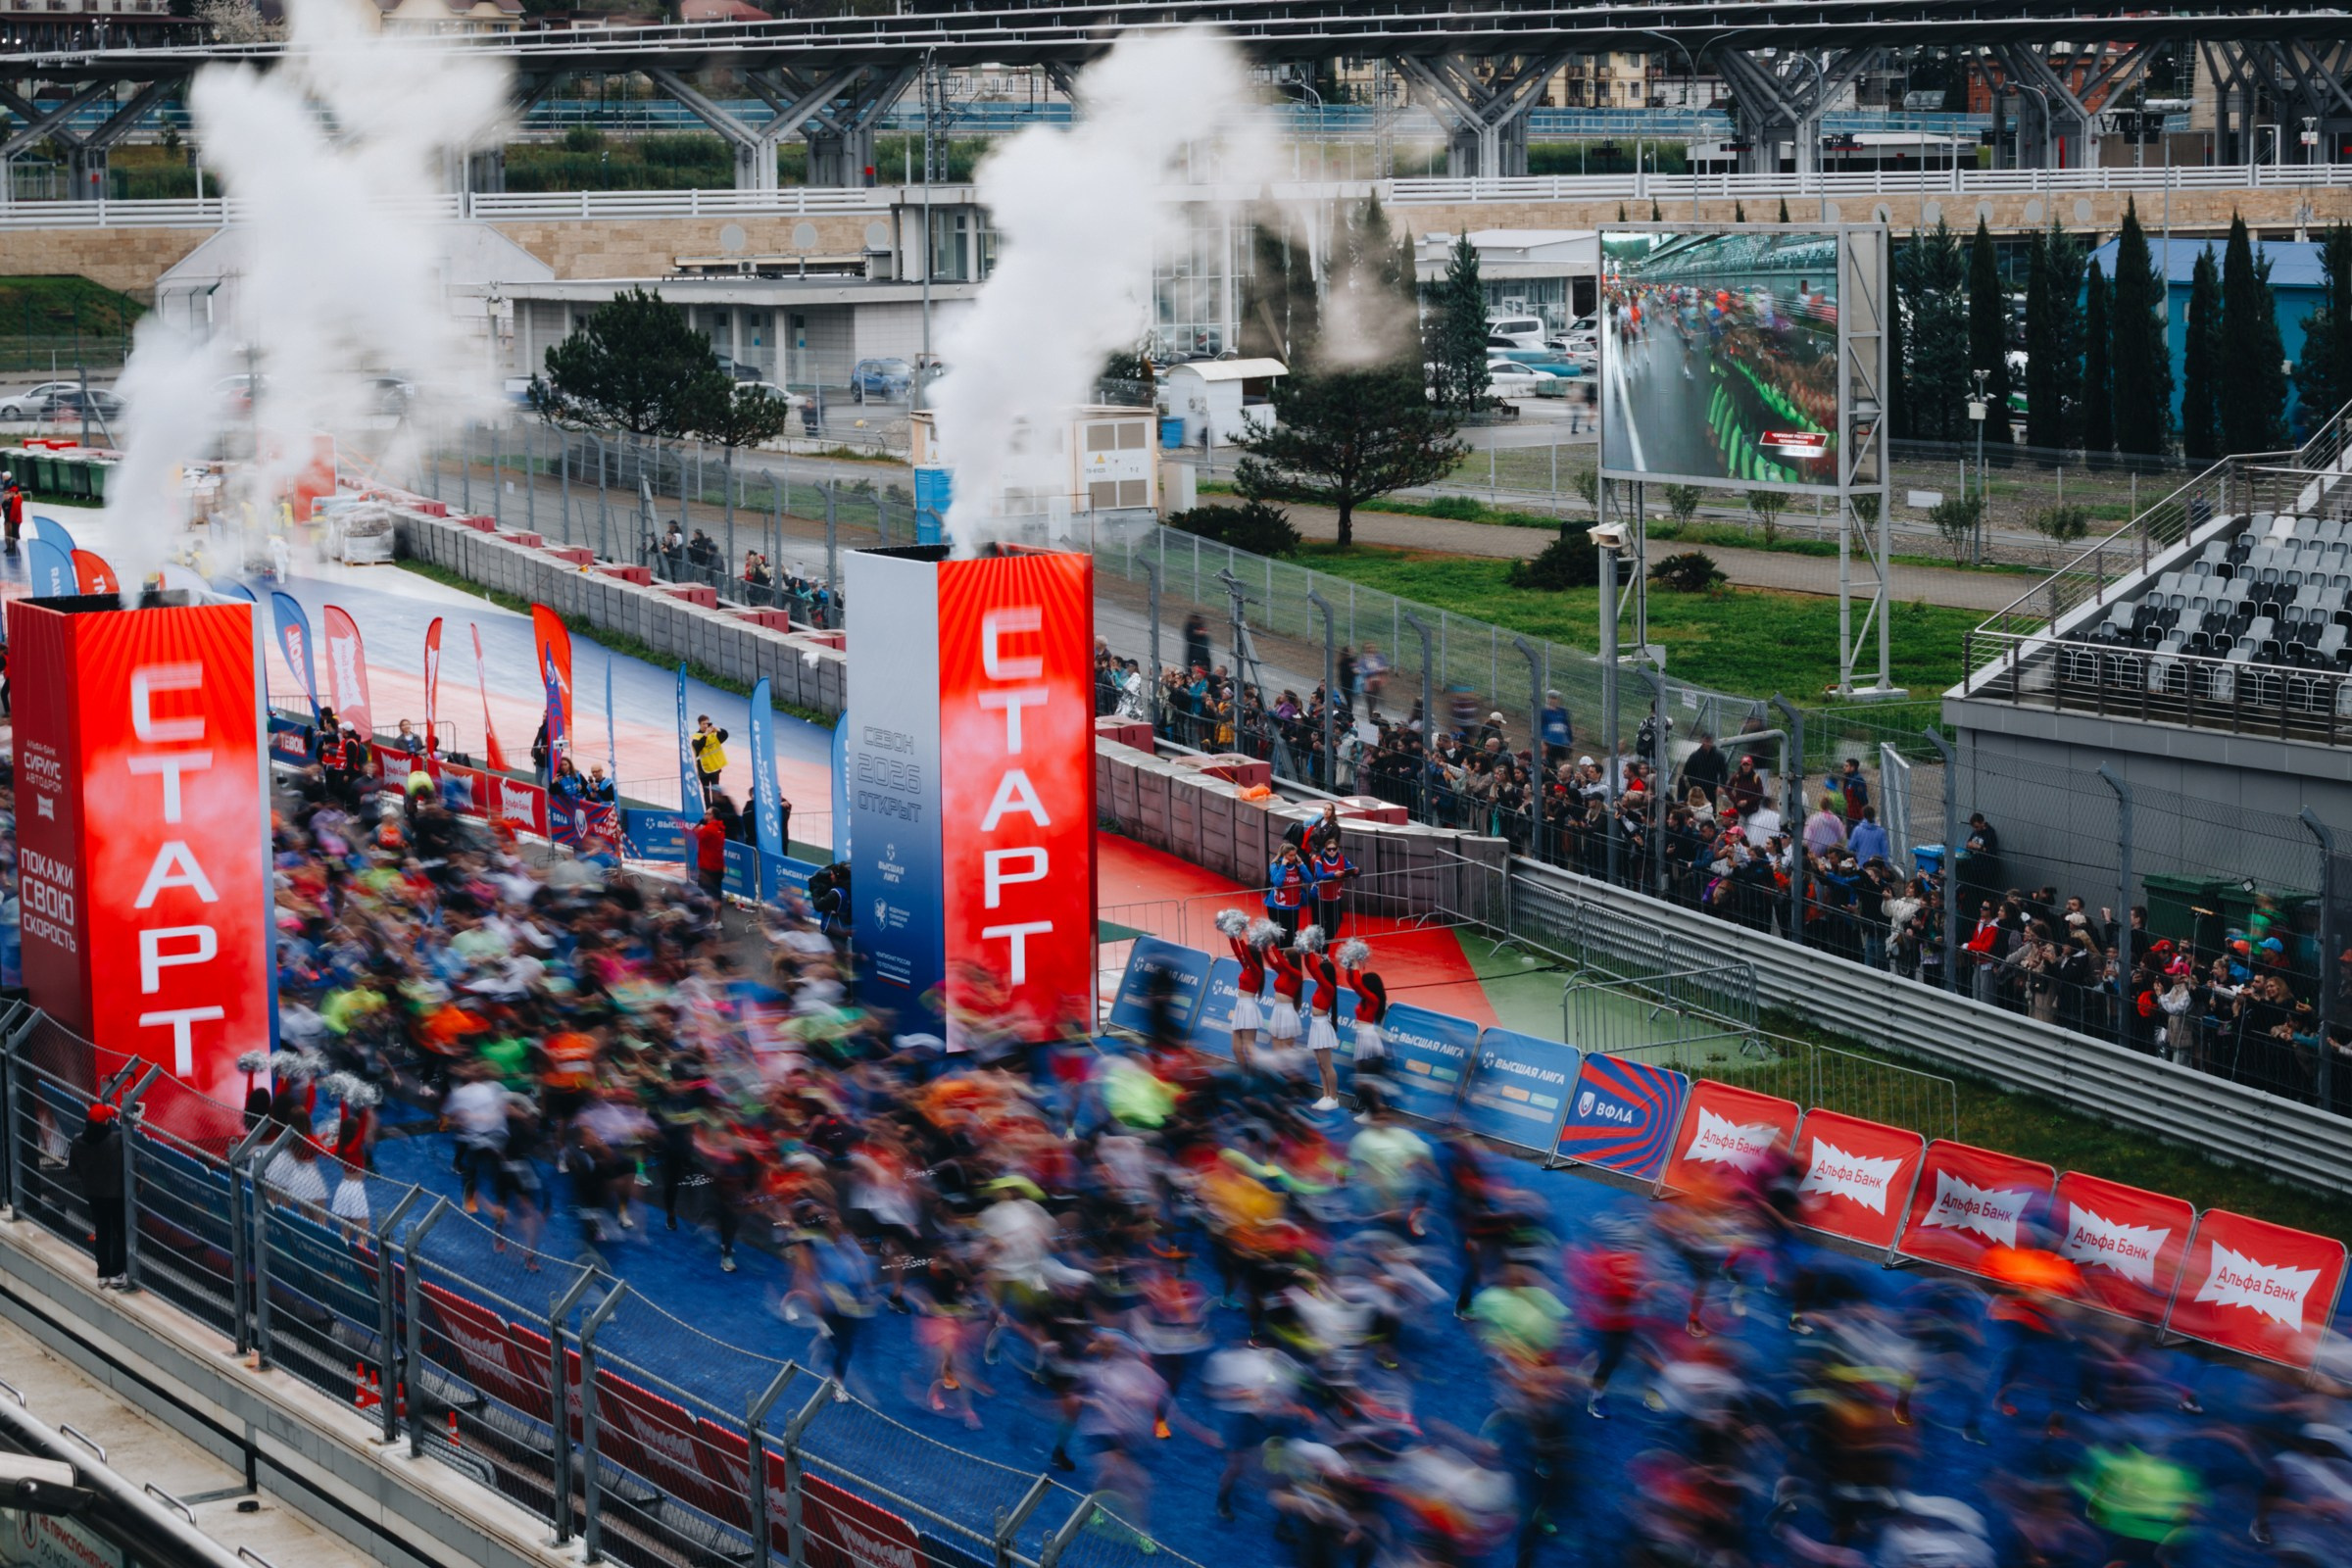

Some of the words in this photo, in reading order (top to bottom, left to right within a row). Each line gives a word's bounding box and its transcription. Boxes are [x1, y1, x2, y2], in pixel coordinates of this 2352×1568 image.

[863, 726, 914, 755] СЕЗОН
[24, 752, 62, 780] СИРИУС
[858, 753, 921, 795] 2026
[25, 771, 63, 795] АВТОДРОМ
[977, 604, 1054, 985] СТАРТ
[858, 790, 921, 822] ОТКРЫТ
[21, 848, 74, 890] ПОКАЖИ
[127, 661, 224, 1078] СТАРТ
[878, 860, 905, 876] ВЫСШАЯ
[883, 872, 900, 884] ЛИГА
[23, 875, 74, 926] СВОЮ
[24, 912, 76, 954] СКОРОСТЬ
[1176, 972, 1200, 987] ЛИГА
[1398, 1032, 1441, 1052] ВЫСШАЯ
[1439, 1044, 1466, 1058] ЛИГА
[1494, 1058, 1540, 1078] ВЫСШАЯ
[1537, 1070, 1565, 1085] ЛИГА
[1595, 1102, 1633, 1124] ВФЛА
[1701, 1128, 1735, 1152] Альфа
[1736, 1137, 1763, 1157] Банк
[1816, 1159, 1853, 1183] Альфа
[1854, 1168, 1884, 1189] Банк
[1940, 1192, 1981, 1219] Альфа
[1982, 1201, 2014, 1223] Банк
[2074, 1226, 2115, 1253] Альфа
[2116, 1238, 2150, 1260] Банк
[2217, 1265, 2261, 1294] Альфа
[2263, 1278, 2299, 1303] Банк
[39, 1514, 49, 1533] НЕ
[40, 1539, 52, 1560] DO
